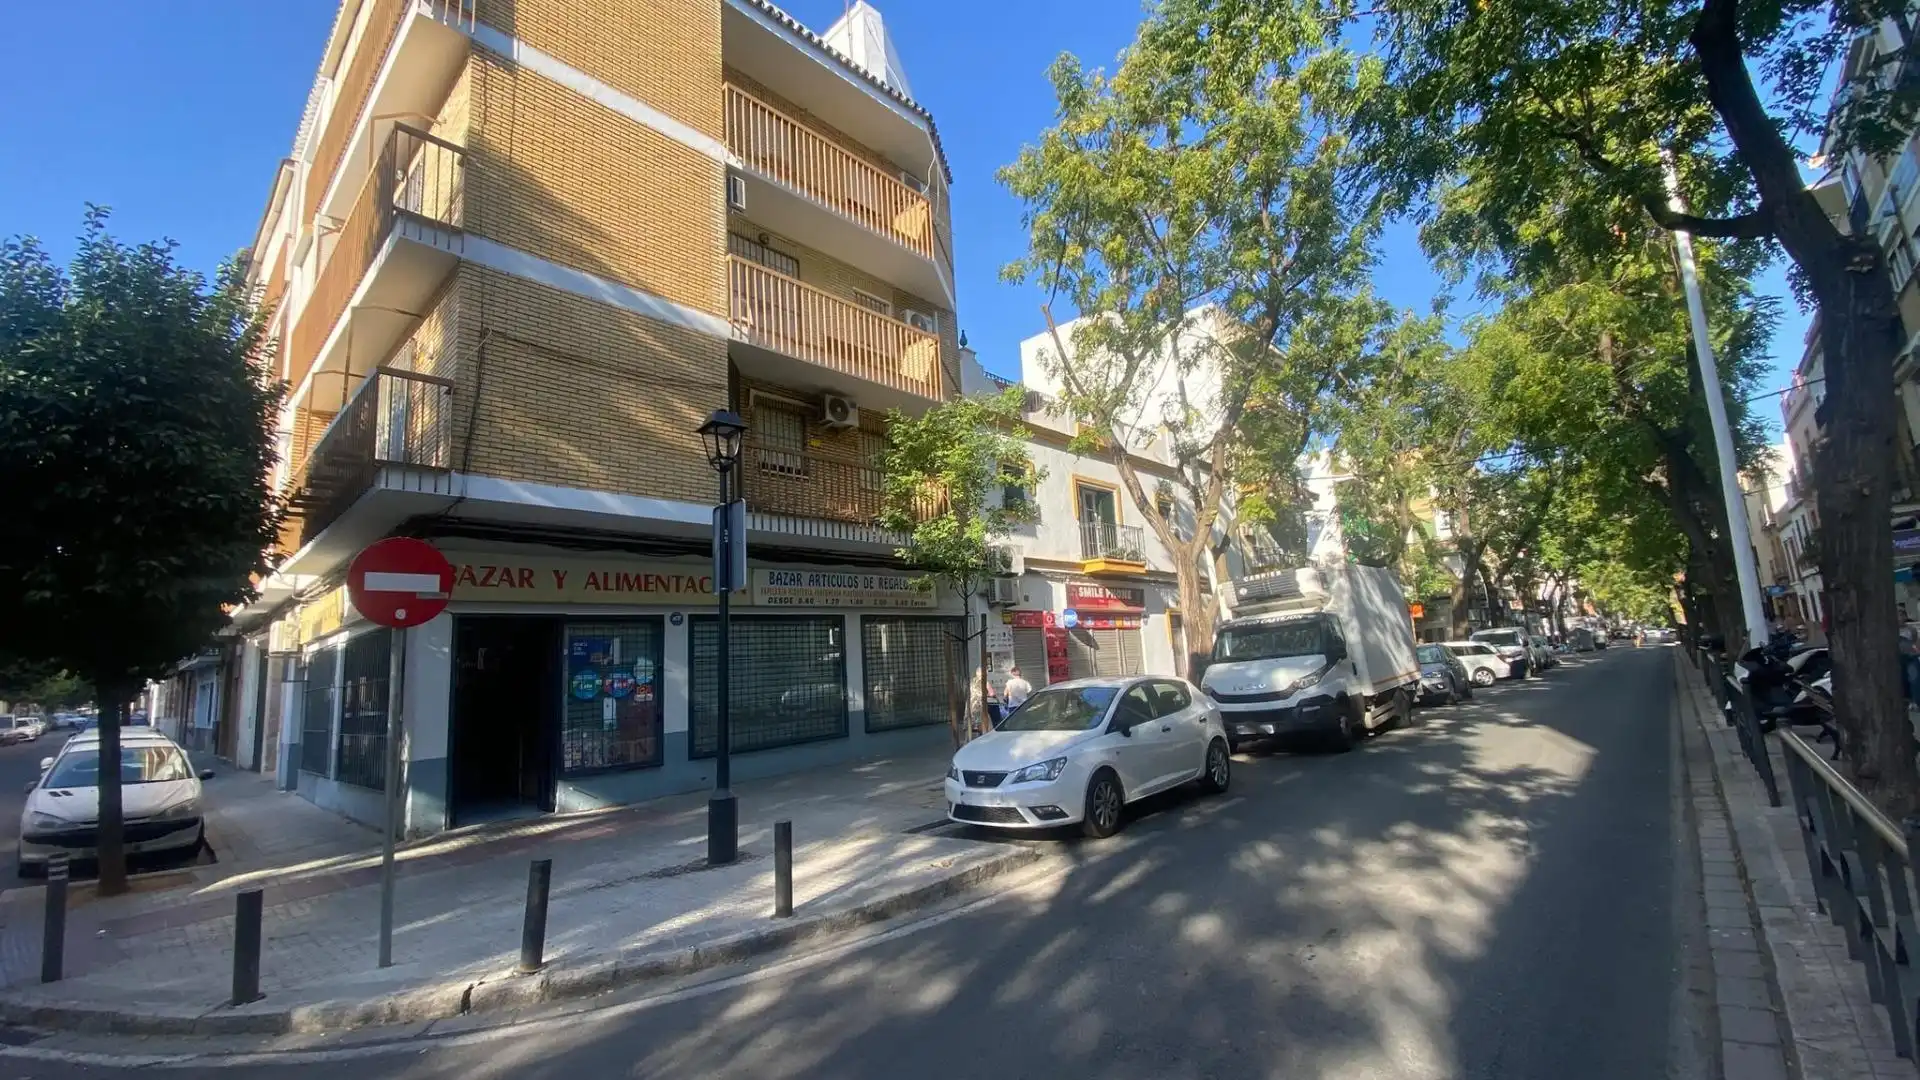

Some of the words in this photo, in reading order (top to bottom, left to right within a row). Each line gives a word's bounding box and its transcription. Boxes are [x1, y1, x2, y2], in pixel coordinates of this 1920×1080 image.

[552, 569, 568, 589] Y
[584, 571, 712, 594] ALIMENTAC
[769, 571, 802, 587] BAZAR
[808, 573, 859, 589] ARTICULOS
[864, 576, 873, 589] DE
[1243, 570, 1282, 582] CARRIER
[768, 596, 794, 604] DESDE
[1078, 586, 1104, 598] SMILE
[1105, 588, 1133, 600] PHONE
